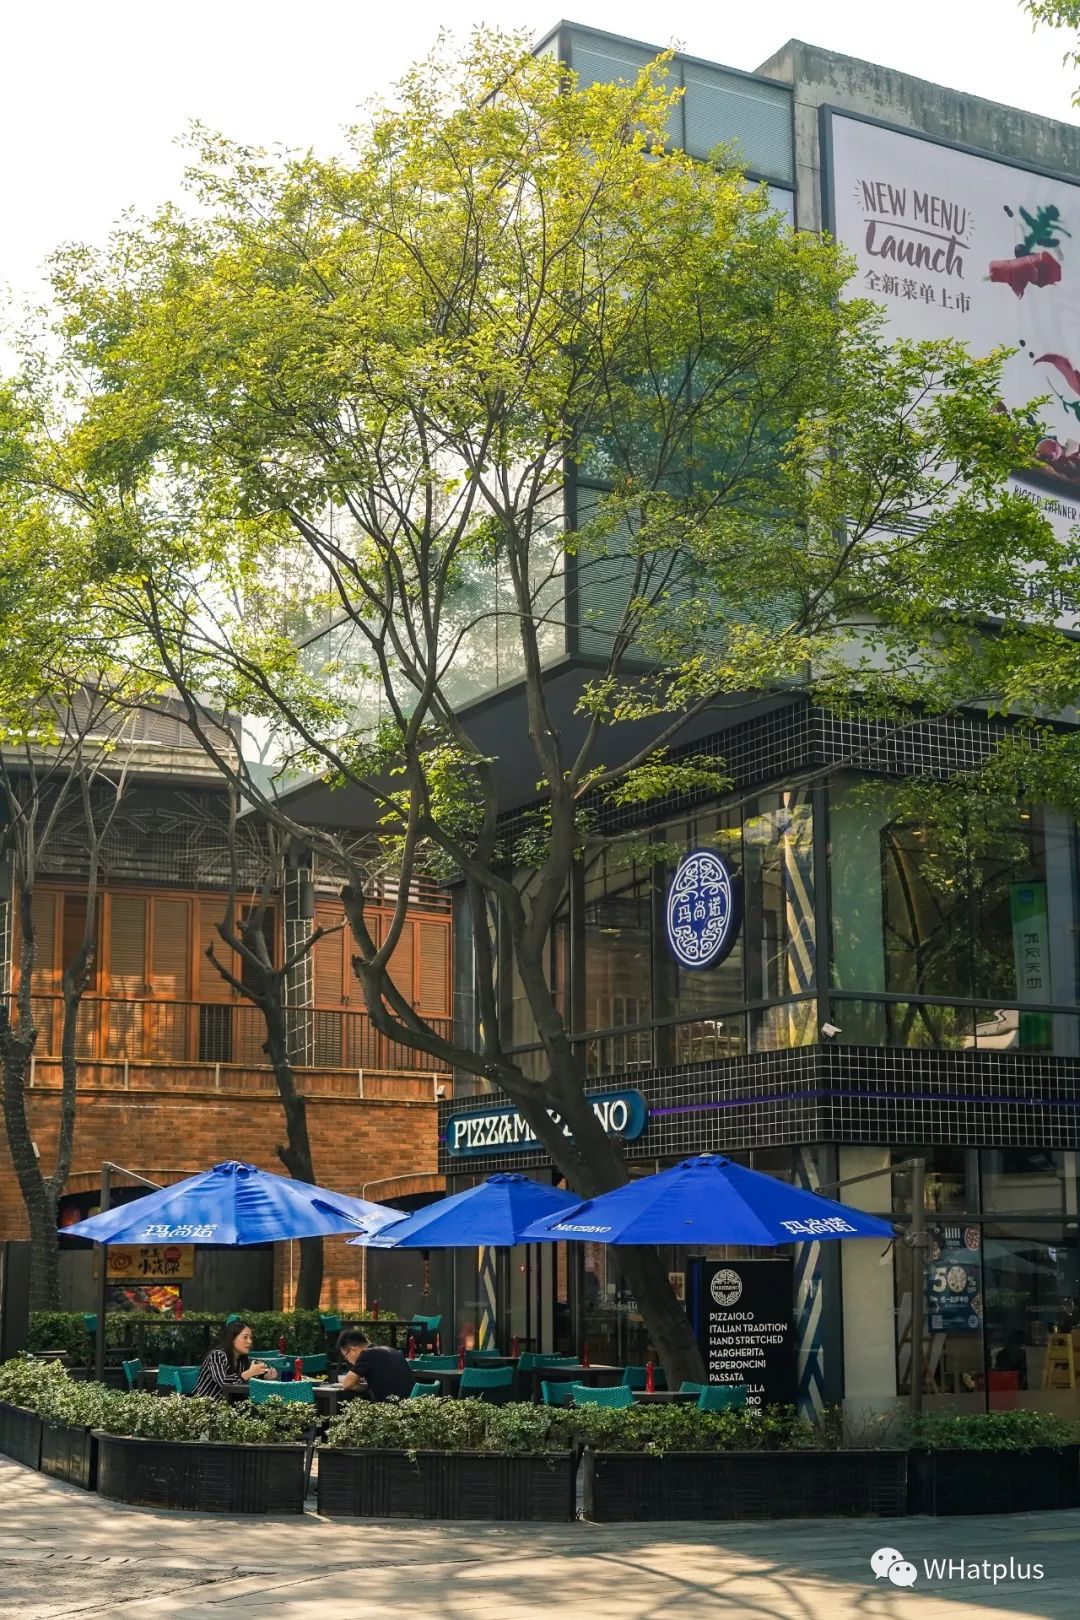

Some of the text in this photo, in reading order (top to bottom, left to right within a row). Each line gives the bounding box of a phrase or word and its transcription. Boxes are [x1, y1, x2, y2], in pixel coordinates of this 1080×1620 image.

[862, 180, 966, 235] NEW MENU
[865, 221, 965, 280] Launch
[863, 269, 971, 313] 全新菜单上市
[453, 1099, 629, 1149] PIZZAMNO
[141, 1223, 218, 1238] 玛尚诺
[709, 1311, 754, 1321] PIZZAIOLO
[709, 1323, 788, 1334] ITALIAN TRADITION
[709, 1335, 784, 1345] HAND STRETCHED
[709, 1347, 765, 1358] MARGHERITA
[709, 1359, 767, 1370] PEPERONCINI
[709, 1372, 744, 1382] PASSATA
